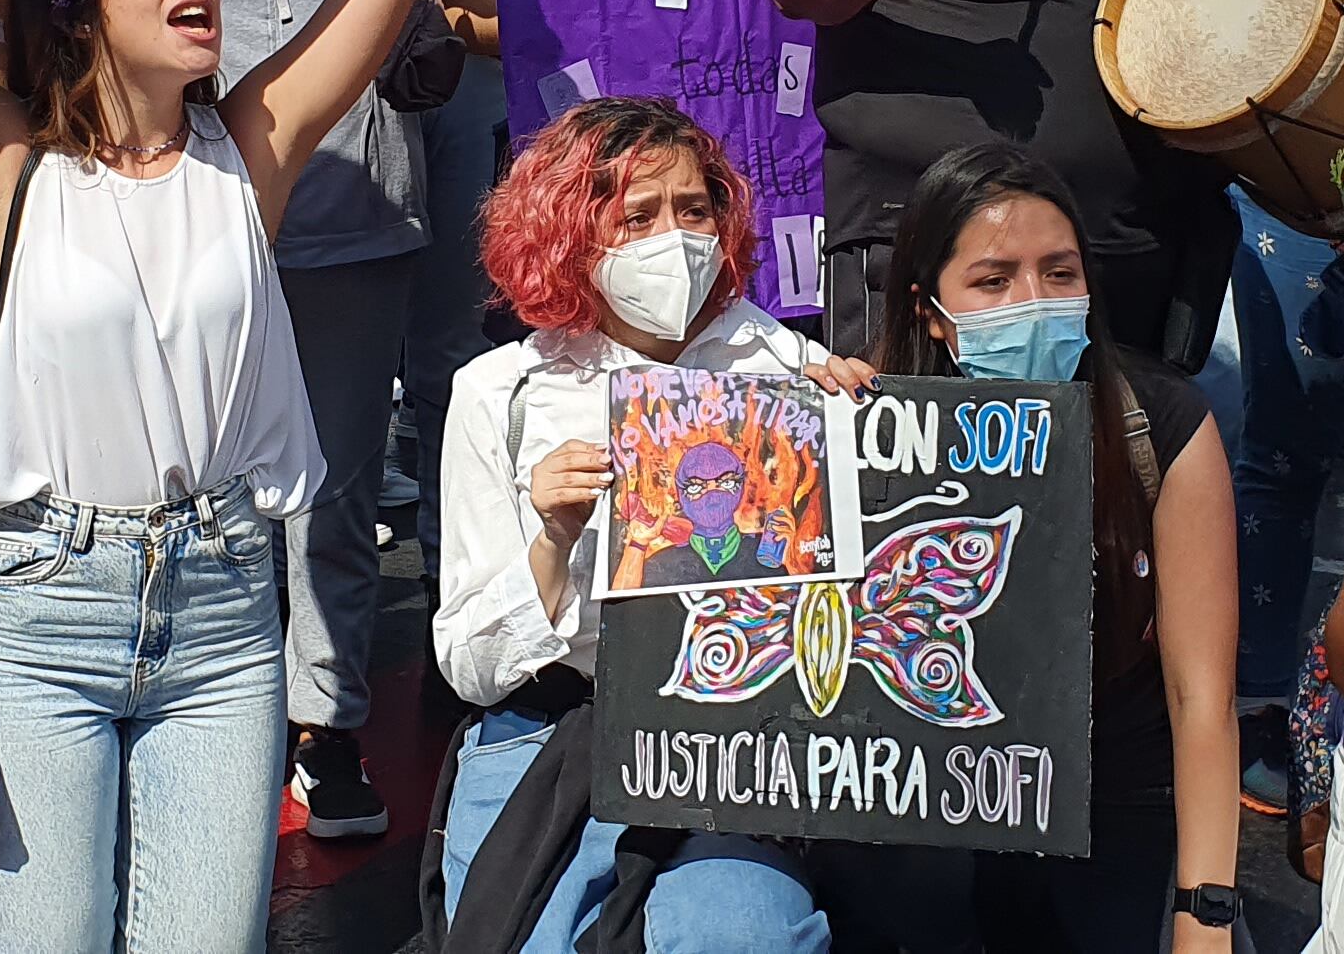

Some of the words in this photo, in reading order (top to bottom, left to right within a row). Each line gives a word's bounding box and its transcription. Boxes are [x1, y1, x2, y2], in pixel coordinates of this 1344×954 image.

[611, 368, 644, 403] NO
[949, 398, 1052, 477] SOFI
[621, 729, 800, 810] JUSTICIA
[806, 733, 928, 819] PARA
[940, 744, 1054, 834] SOFI
